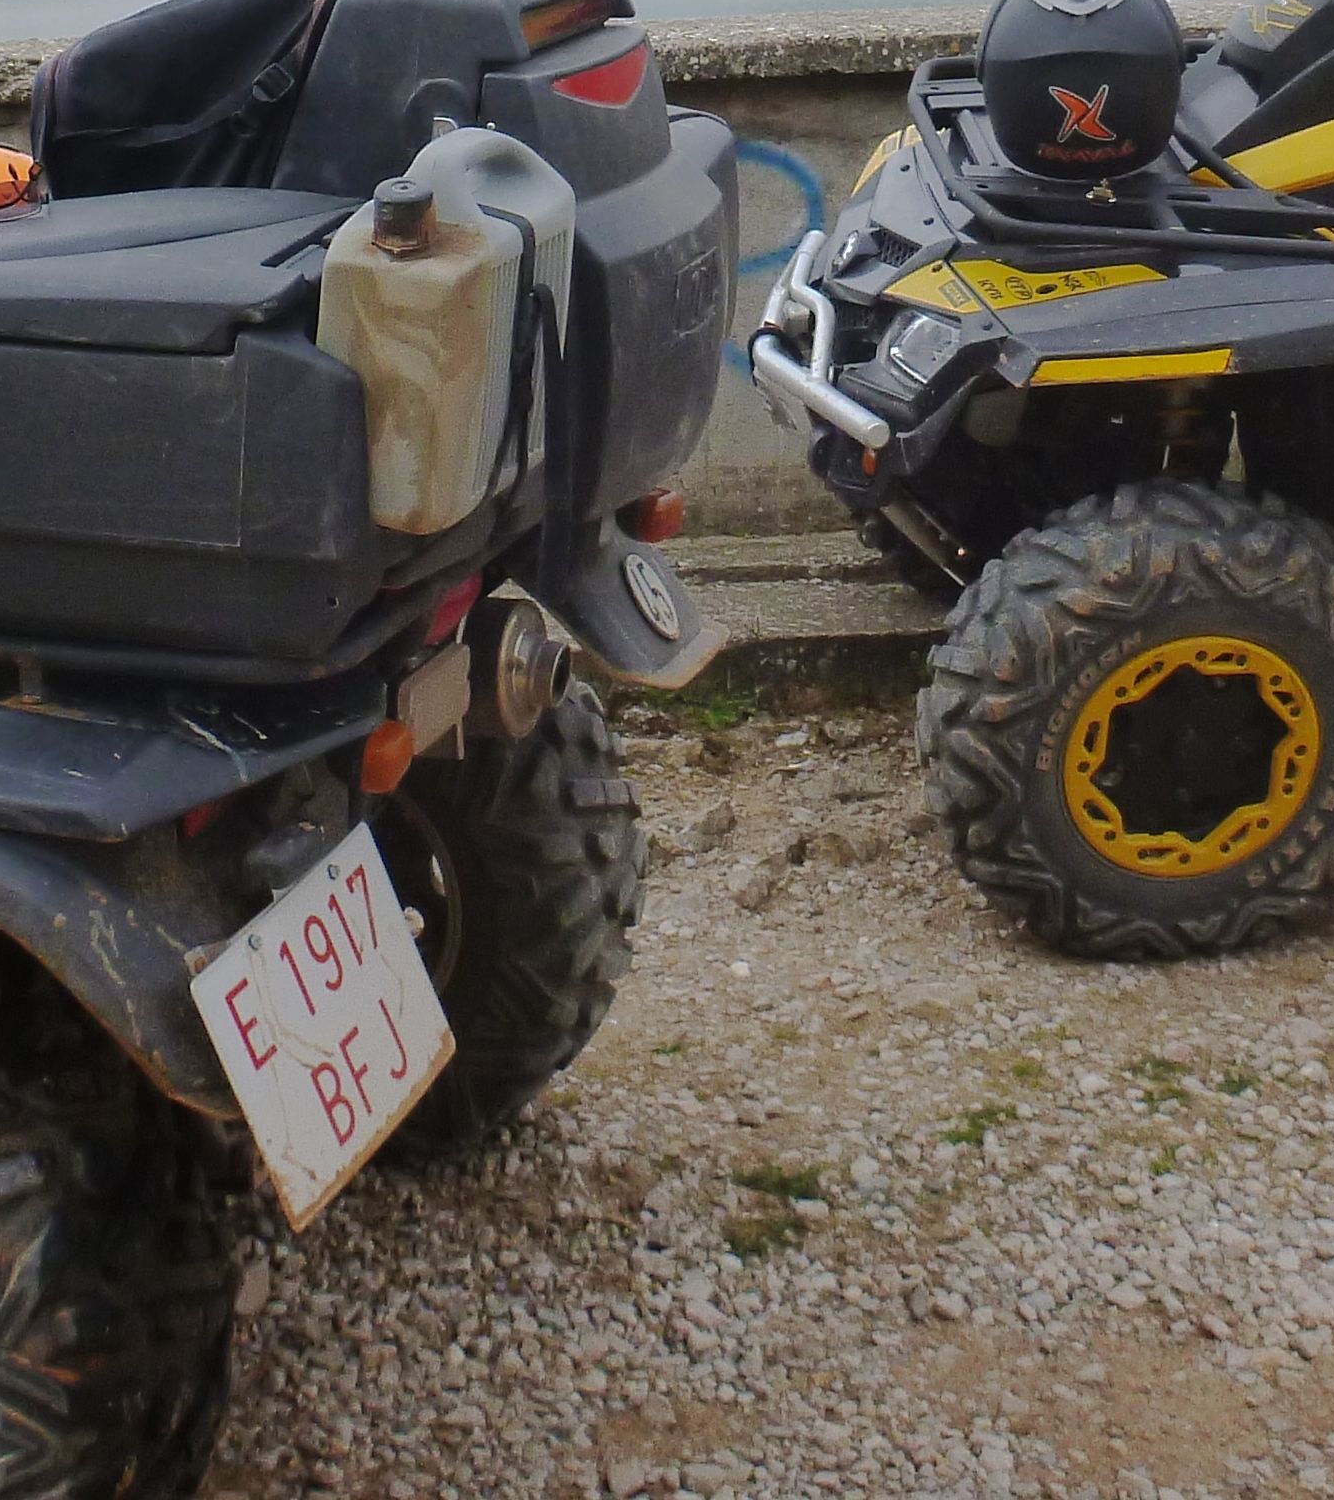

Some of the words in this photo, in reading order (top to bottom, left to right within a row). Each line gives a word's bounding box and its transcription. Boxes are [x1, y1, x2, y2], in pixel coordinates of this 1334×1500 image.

[224, 977, 279, 1072] E
[278, 863, 379, 1017] 1917
[309, 998, 409, 1147] BFJ
